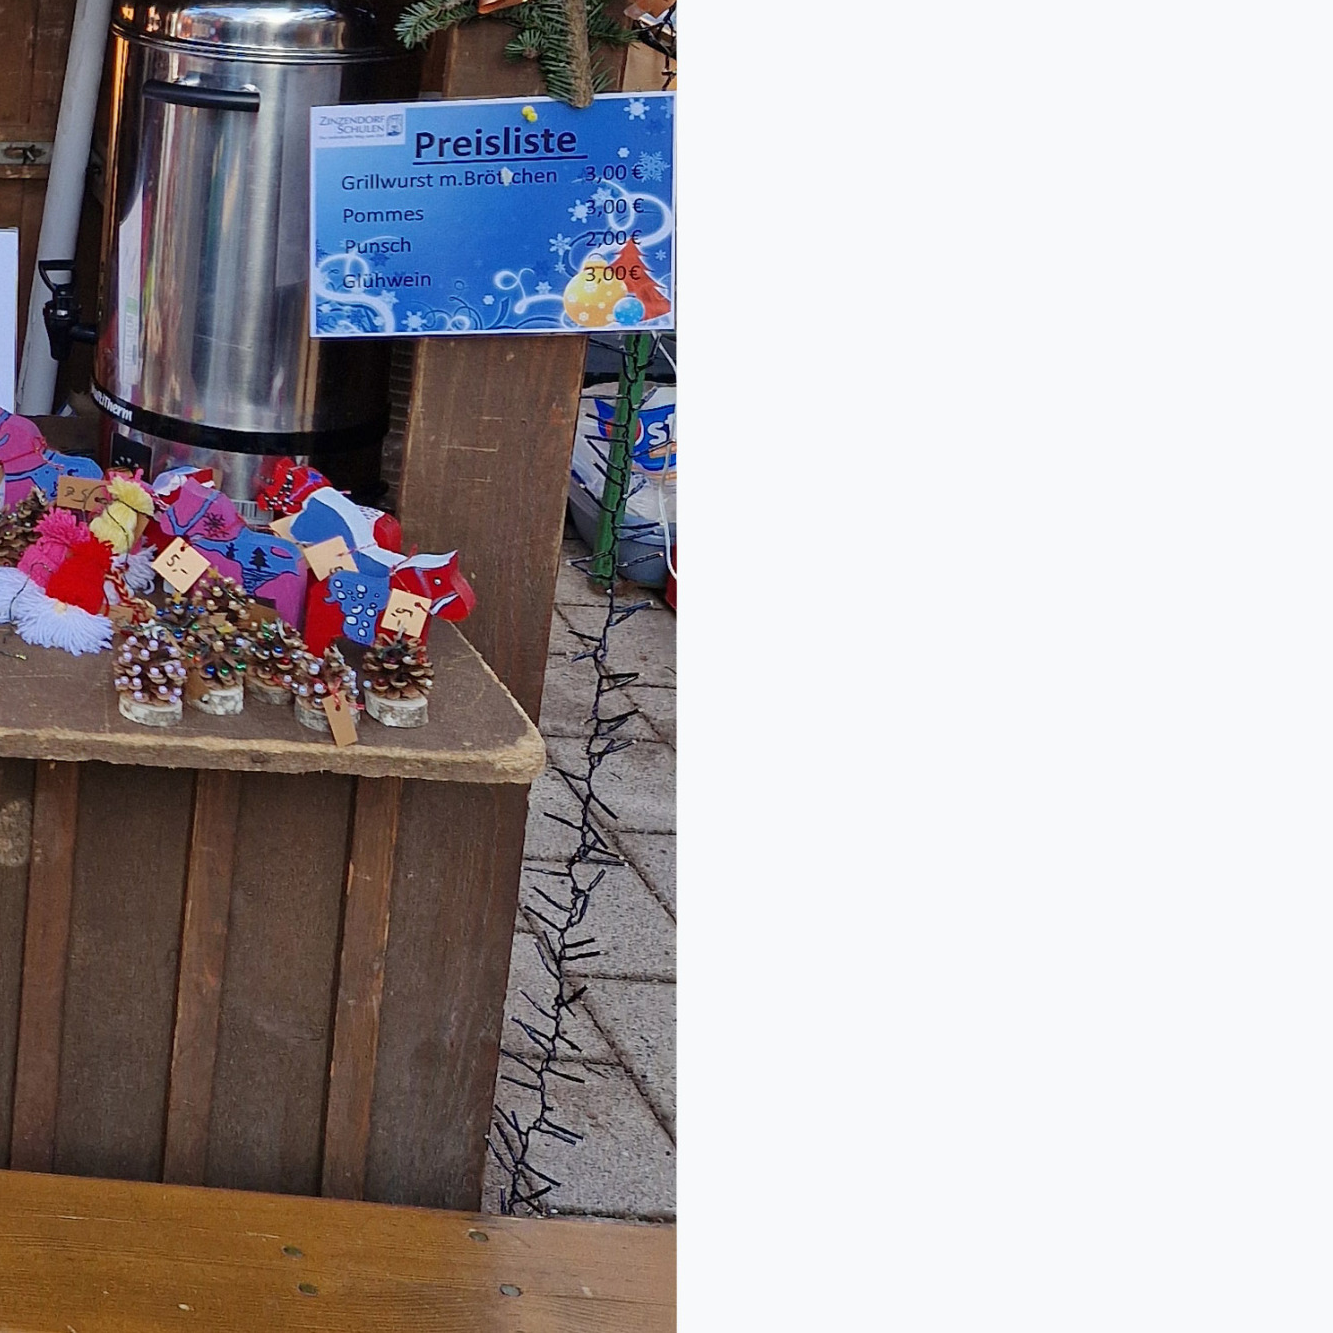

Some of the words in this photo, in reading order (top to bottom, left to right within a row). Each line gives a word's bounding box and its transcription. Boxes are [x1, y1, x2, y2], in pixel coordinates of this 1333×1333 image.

[319, 115, 385, 126] ZINZENDORF
[337, 124, 385, 134] SCHULEN
[415, 126, 577, 158] Preisliste
[342, 173, 433, 190] Grillwurst
[585, 165, 627, 183] 3,00
[343, 208, 424, 223] Pommes
[585, 199, 627, 217] 3,00
[345, 237, 411, 254] Punsch
[585, 230, 627, 248] 2,00
[343, 272, 431, 289] Glühwein
